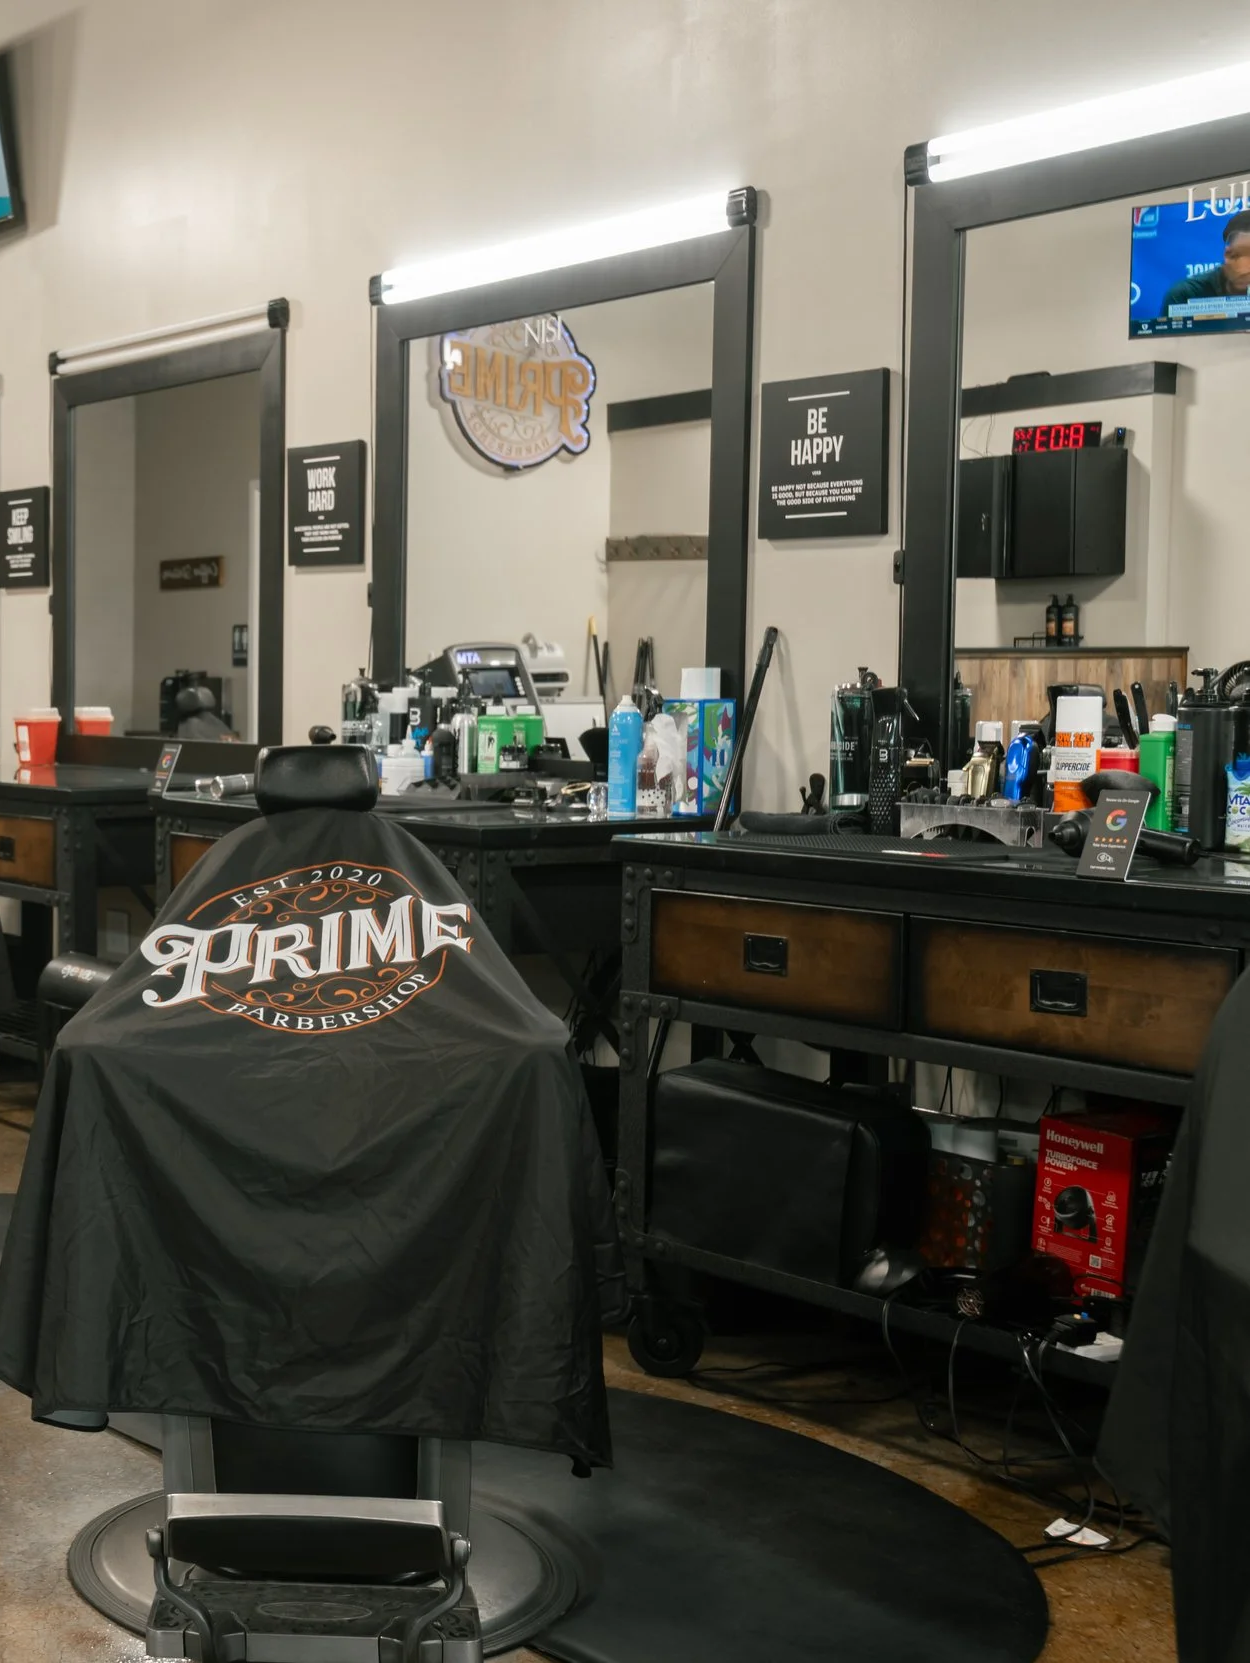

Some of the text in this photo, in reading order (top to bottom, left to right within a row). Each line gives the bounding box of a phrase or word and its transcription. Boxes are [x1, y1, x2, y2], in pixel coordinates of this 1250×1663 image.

[807, 407, 828, 435] BE
[791, 435, 844, 466] HAPPY
[307, 466, 336, 490] WORK
[830, 479, 863, 488] EVERYTHING
[308, 489, 335, 512] HARD
[787, 498, 801, 506] GOOD
[823, 494, 856, 503] EVERYTHING
[806, 489, 828, 497] BECAUSE
[140, 895, 473, 1008] PRIME
[225, 973, 432, 1030] BARBERSHOP
[1046, 1129, 1104, 1154] Honeywell
[1045, 1149, 1098, 1170] TURBOFORCE
[1045, 1156, 1078, 1172] POWER+
